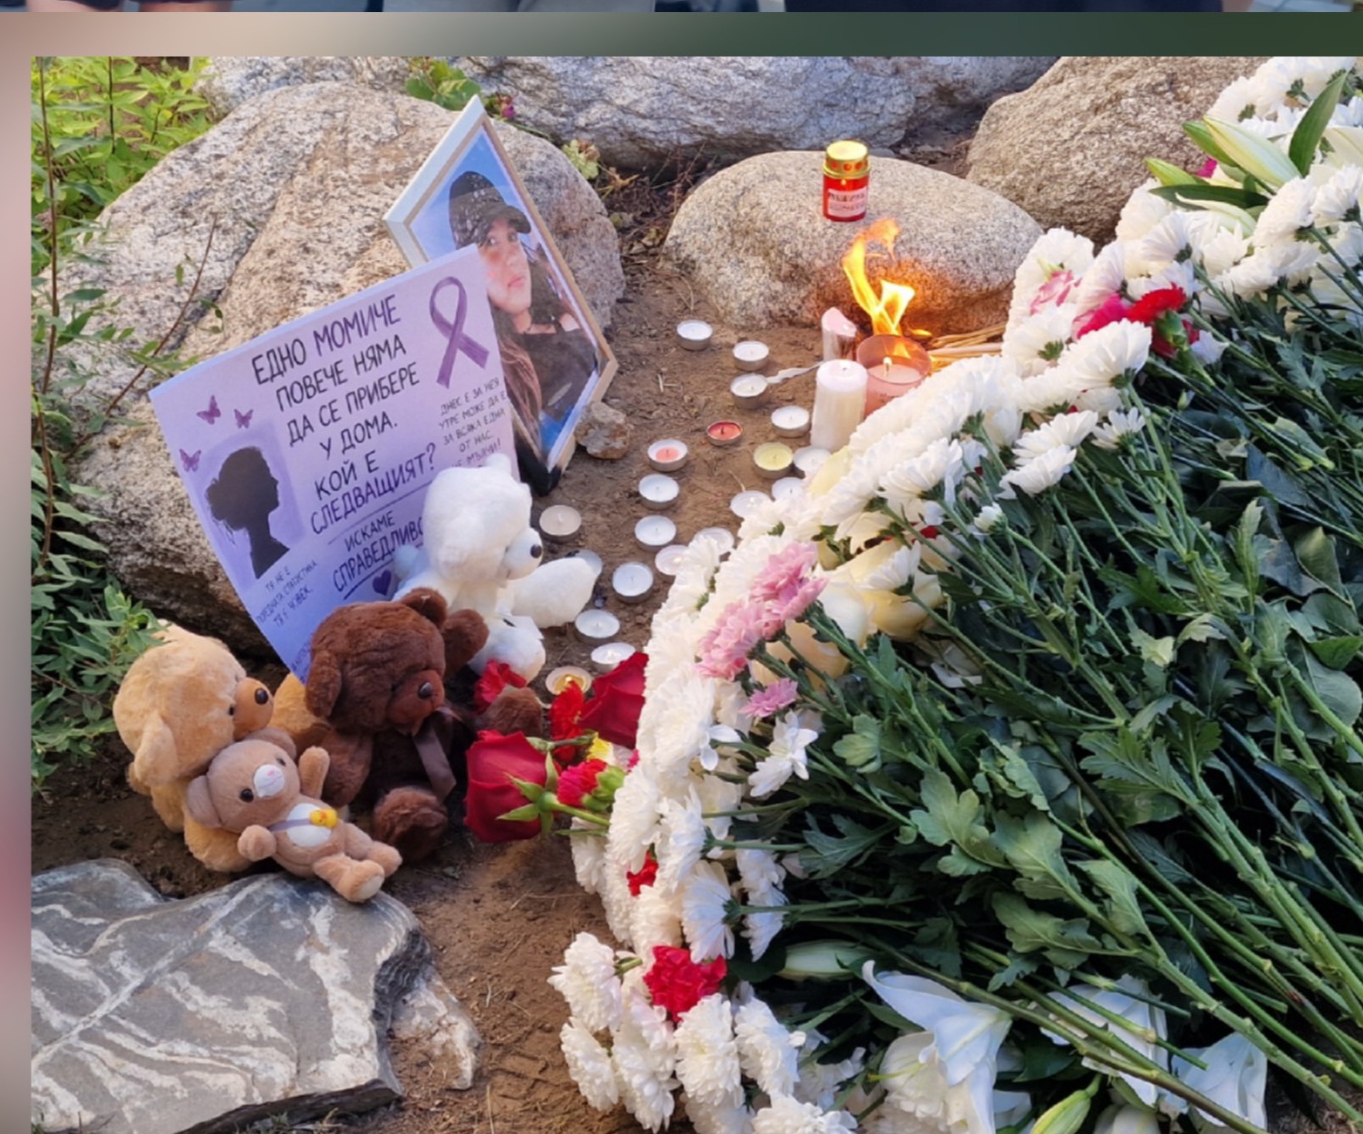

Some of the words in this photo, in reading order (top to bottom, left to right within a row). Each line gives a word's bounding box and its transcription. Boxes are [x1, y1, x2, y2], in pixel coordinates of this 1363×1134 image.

[251, 338, 307, 385] ЕДНО
[313, 294, 401, 357] МОМИЧЕ
[276, 360, 348, 412] ПОВЕЧЕ
[353, 334, 406, 375] НЯМА
[287, 415, 314, 447] ДА
[319, 399, 342, 427] СЕ
[345, 362, 420, 414] ПРИБЕРЕ
[320, 438, 331, 460] У
[341, 411, 398, 454] ДОМА.
[462, 401, 484, 419] МОЖЕ
[311, 442, 436, 535] СЛЕДВАЩИЯТ?
[314, 459, 357, 501] КОЙ
[365, 450, 379, 473] Е
[345, 510, 395, 552] ИСКАМЕ
